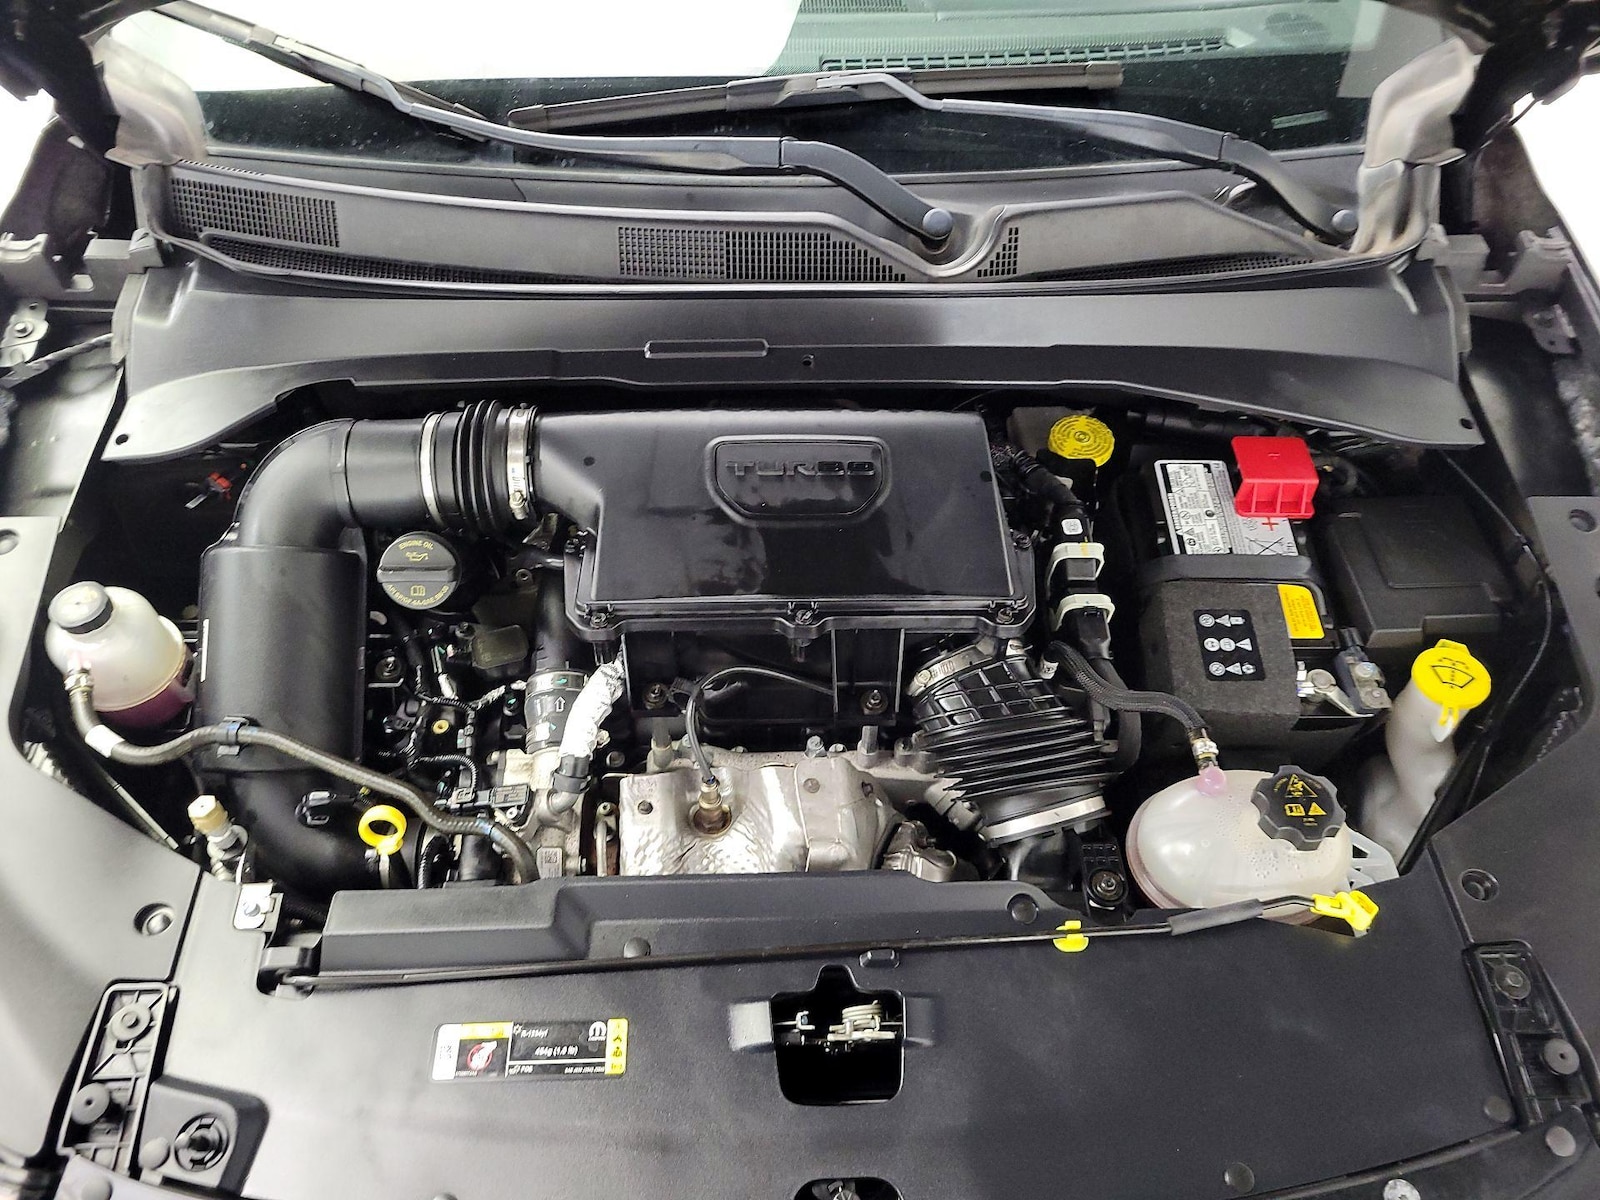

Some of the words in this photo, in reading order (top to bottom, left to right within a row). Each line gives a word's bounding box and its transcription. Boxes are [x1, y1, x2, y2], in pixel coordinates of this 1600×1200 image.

[725, 460, 875, 477] TURBO
[399, 540, 422, 550] ENGINE
[423, 541, 434, 550] OIL
